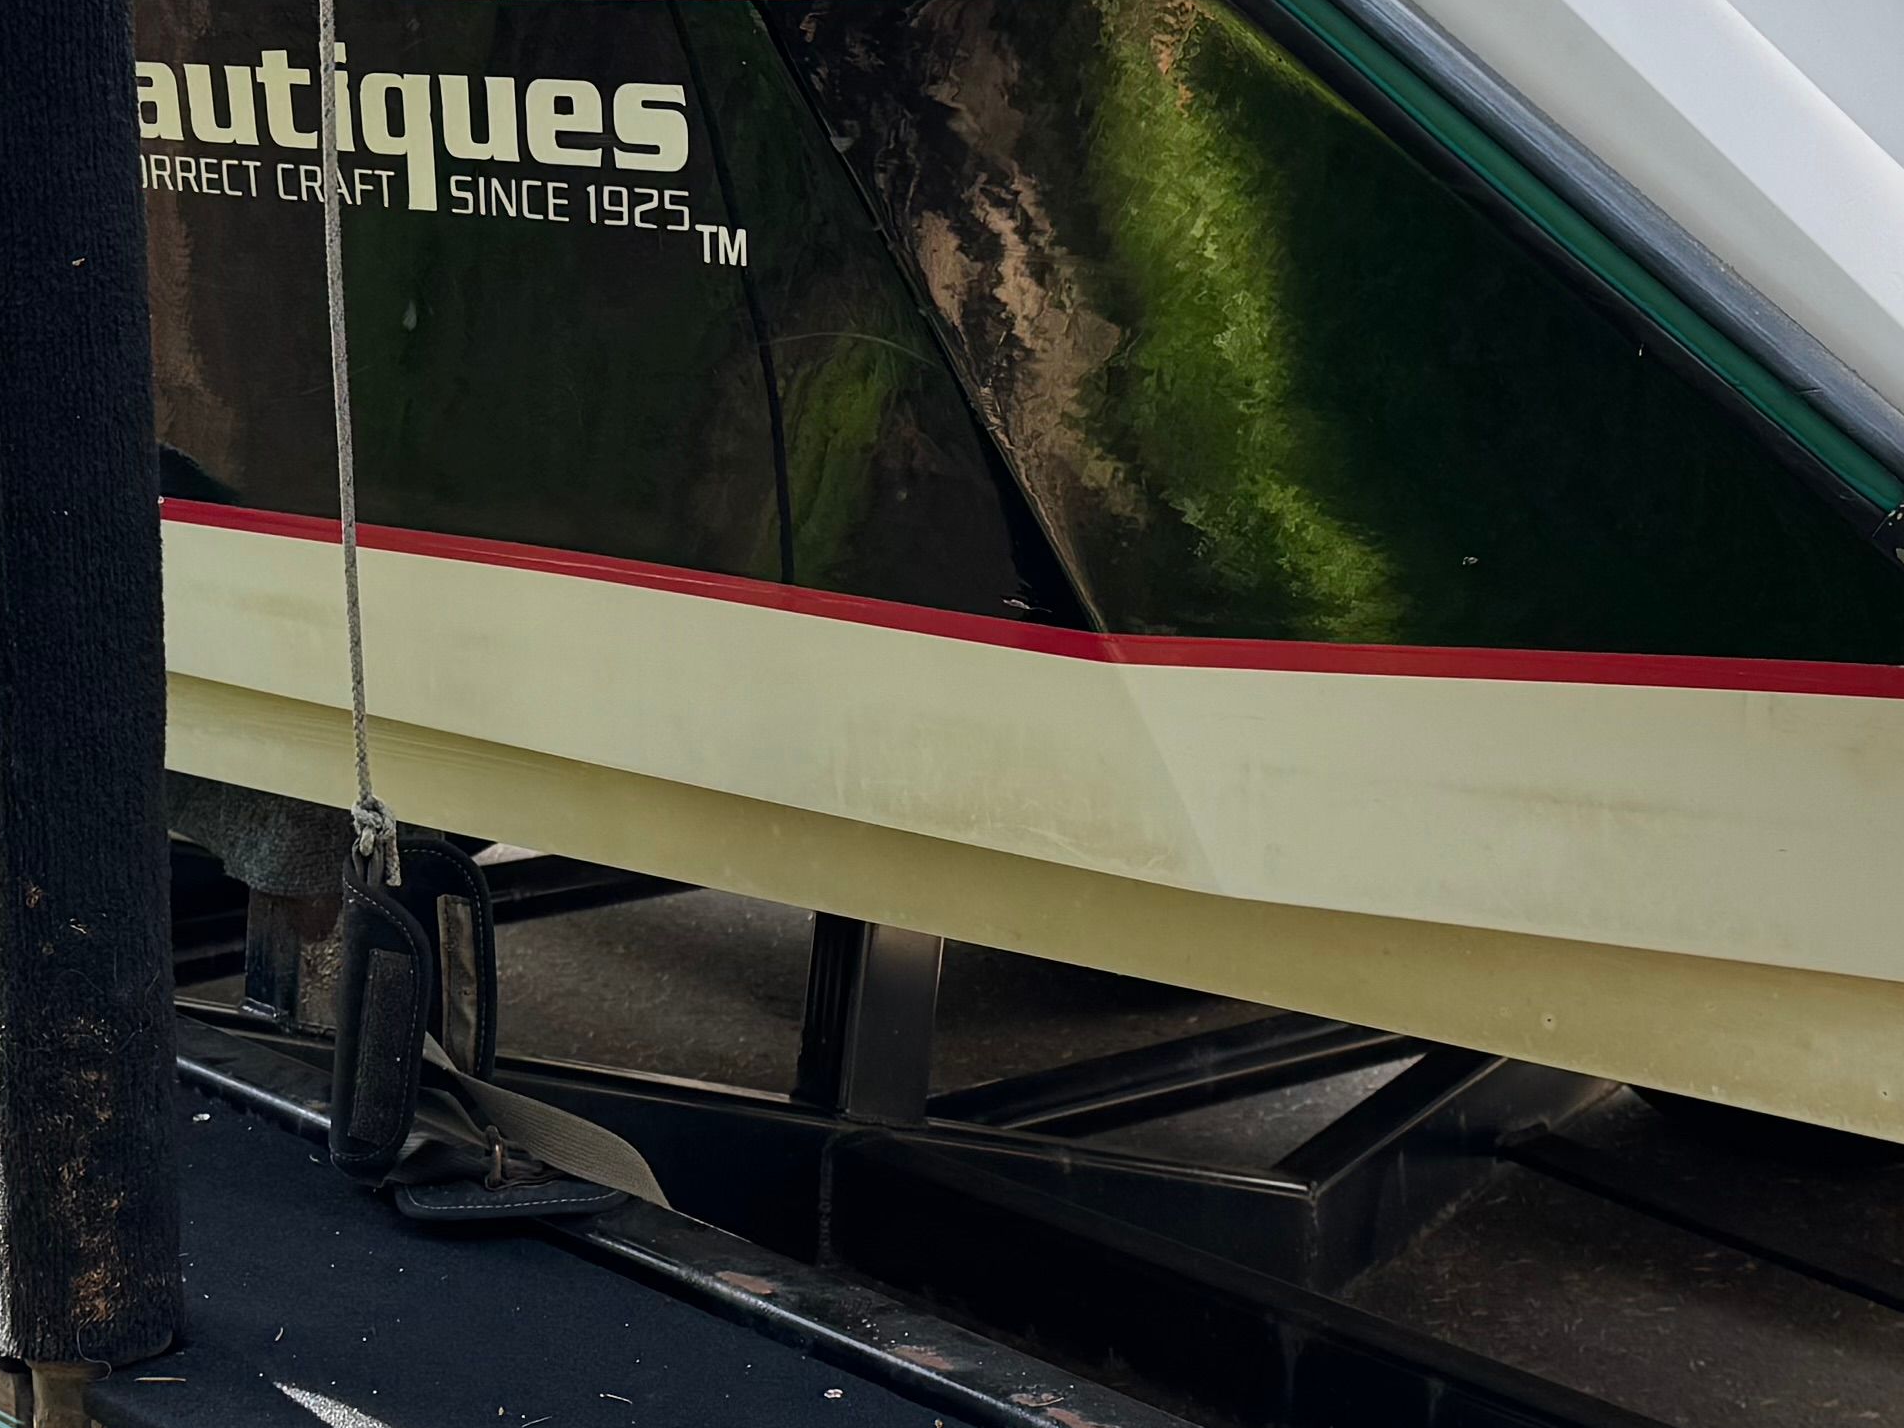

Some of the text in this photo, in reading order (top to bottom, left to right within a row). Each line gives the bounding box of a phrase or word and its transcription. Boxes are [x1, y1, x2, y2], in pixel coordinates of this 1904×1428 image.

[135, 42, 689, 211] autiques
[140, 154, 261, 198] RRECT
[450, 175, 570, 222] SINCE
[586, 184, 690, 232] 1925
[695, 224, 748, 267] TM
